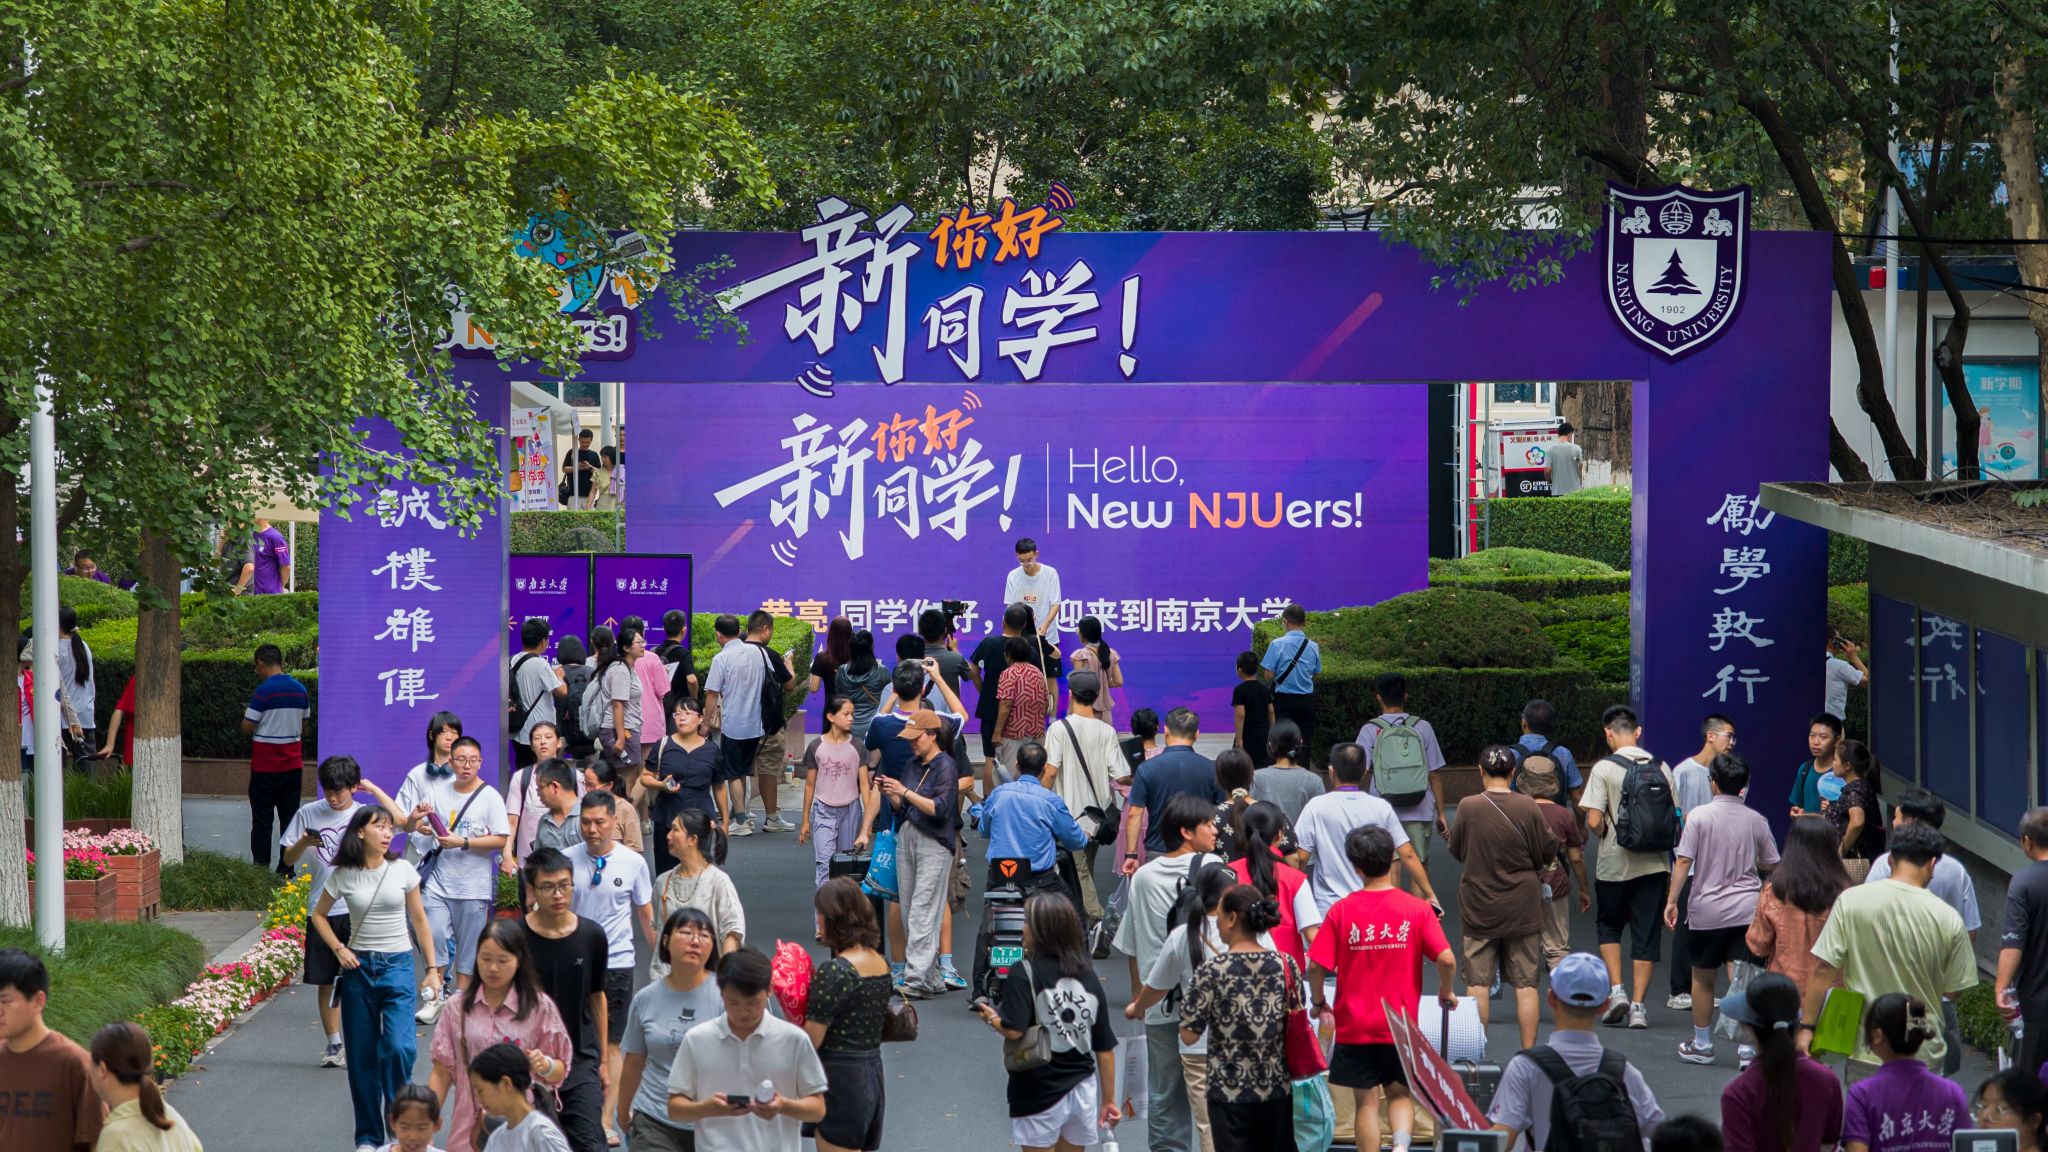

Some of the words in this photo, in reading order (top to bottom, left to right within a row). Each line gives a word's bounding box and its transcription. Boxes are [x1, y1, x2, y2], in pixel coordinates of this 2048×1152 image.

[929, 199, 1063, 269] 你好
[1616, 262, 1655, 333] NANJING
[1666, 265, 1733, 343] UNIVERSITY
[1660, 305, 1686, 314] 1902
[1980, 376, 2022, 391] 新学期
[871, 404, 974, 463] 你好
[1069, 445, 1185, 486] Hello,
[1068, 493, 1173, 529] New
[1189, 492, 1363, 529] NJUers!
[1048, 990, 1091, 1019] KENZO
